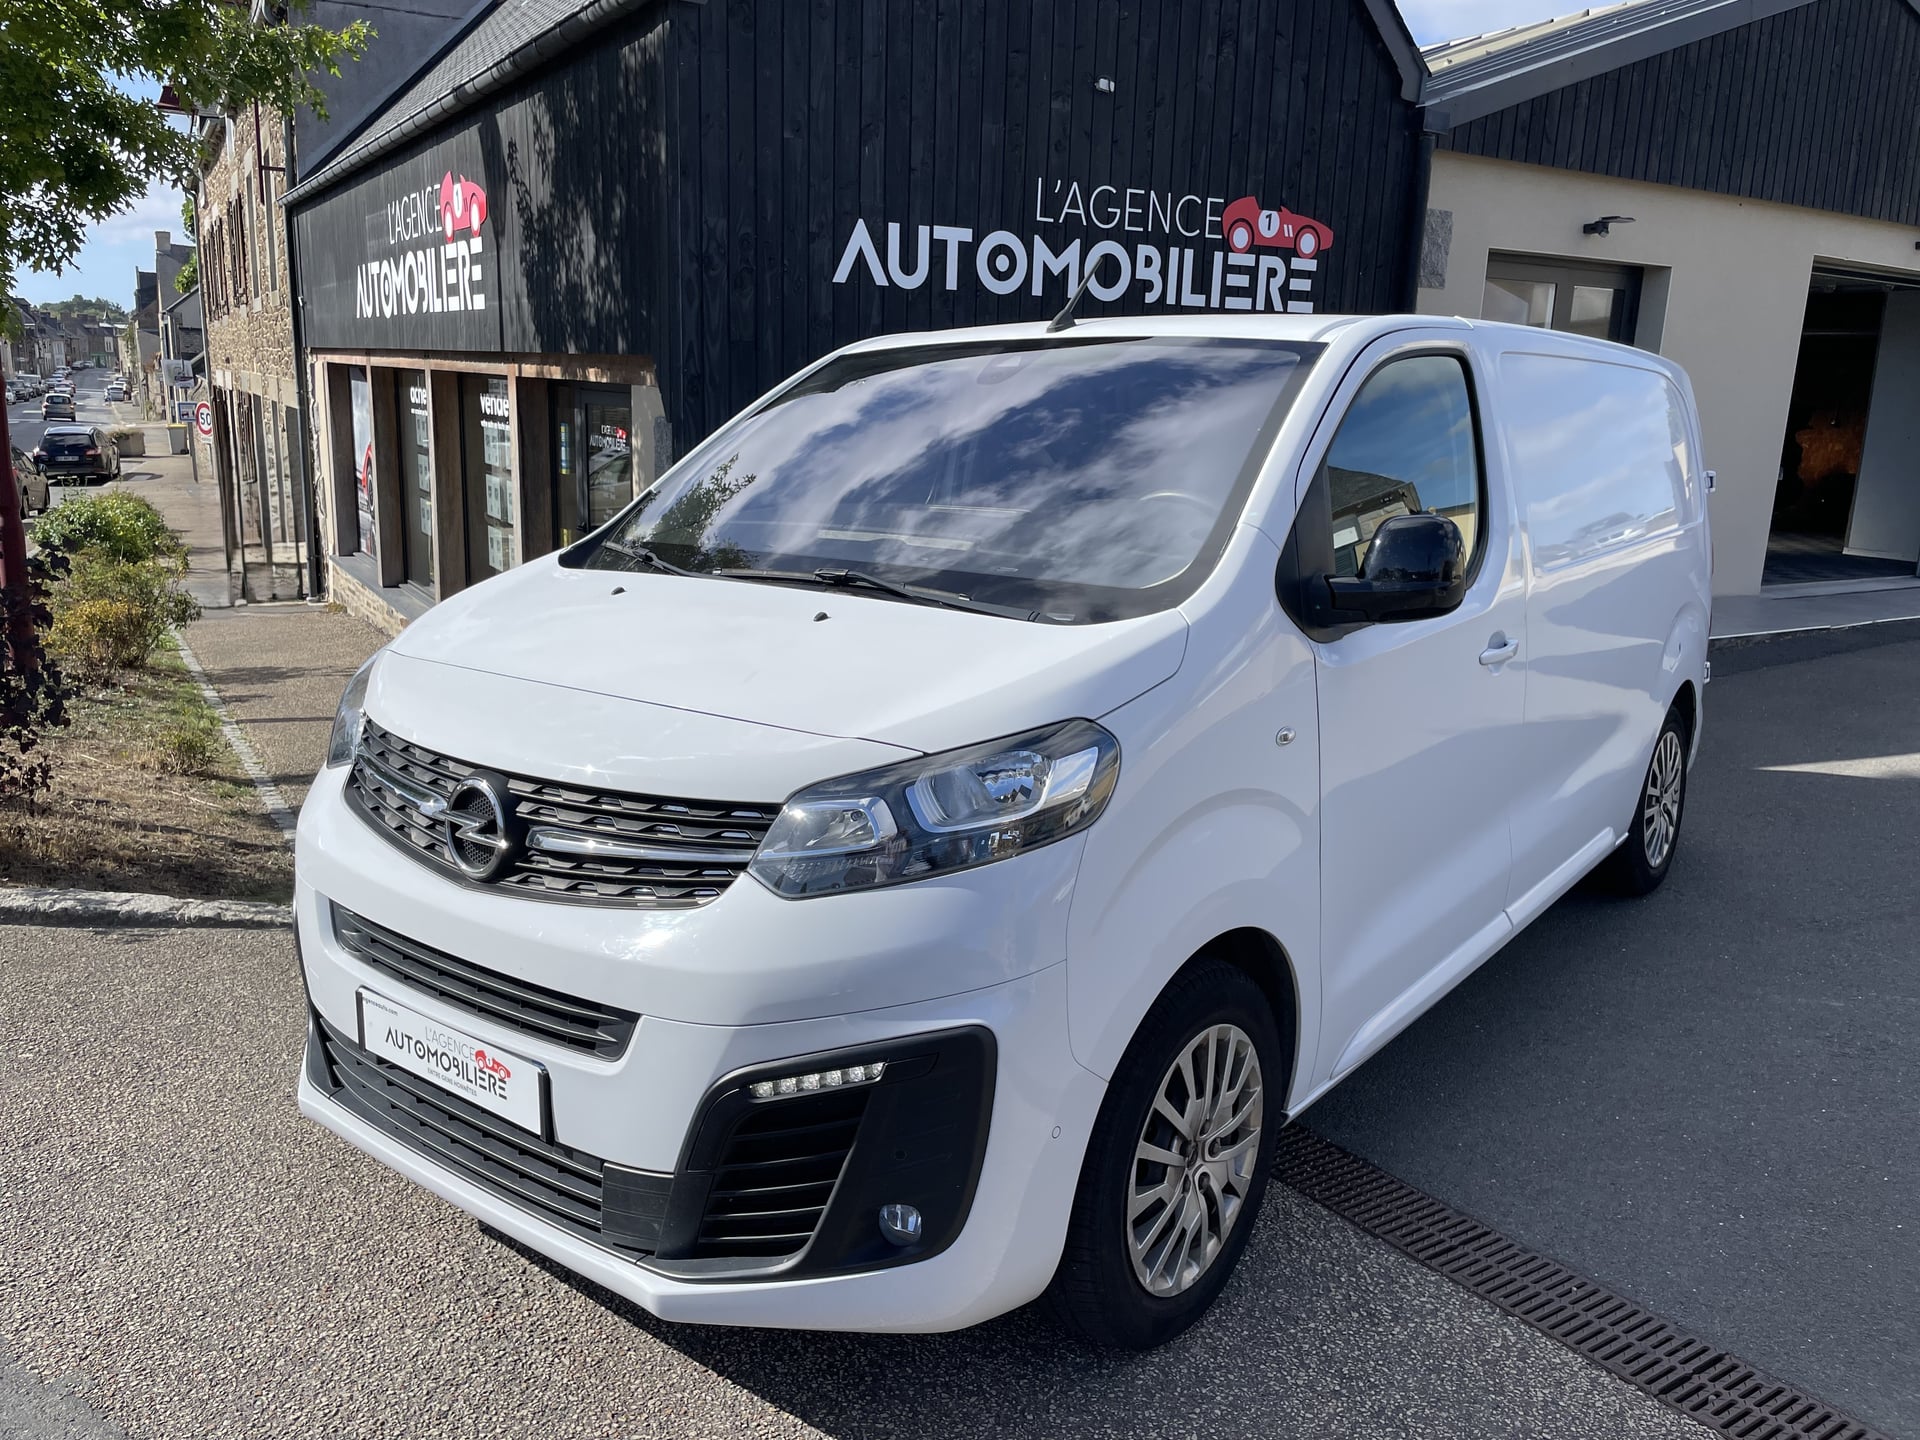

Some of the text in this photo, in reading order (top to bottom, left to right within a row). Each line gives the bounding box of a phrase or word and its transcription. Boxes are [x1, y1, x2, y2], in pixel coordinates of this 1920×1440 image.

[387, 184, 442, 244] L'AGENCE
[1036, 177, 1225, 239] L'AGENCE
[200, 412, 211, 425] 50
[425, 1026, 476, 1062] L'AGENCE
